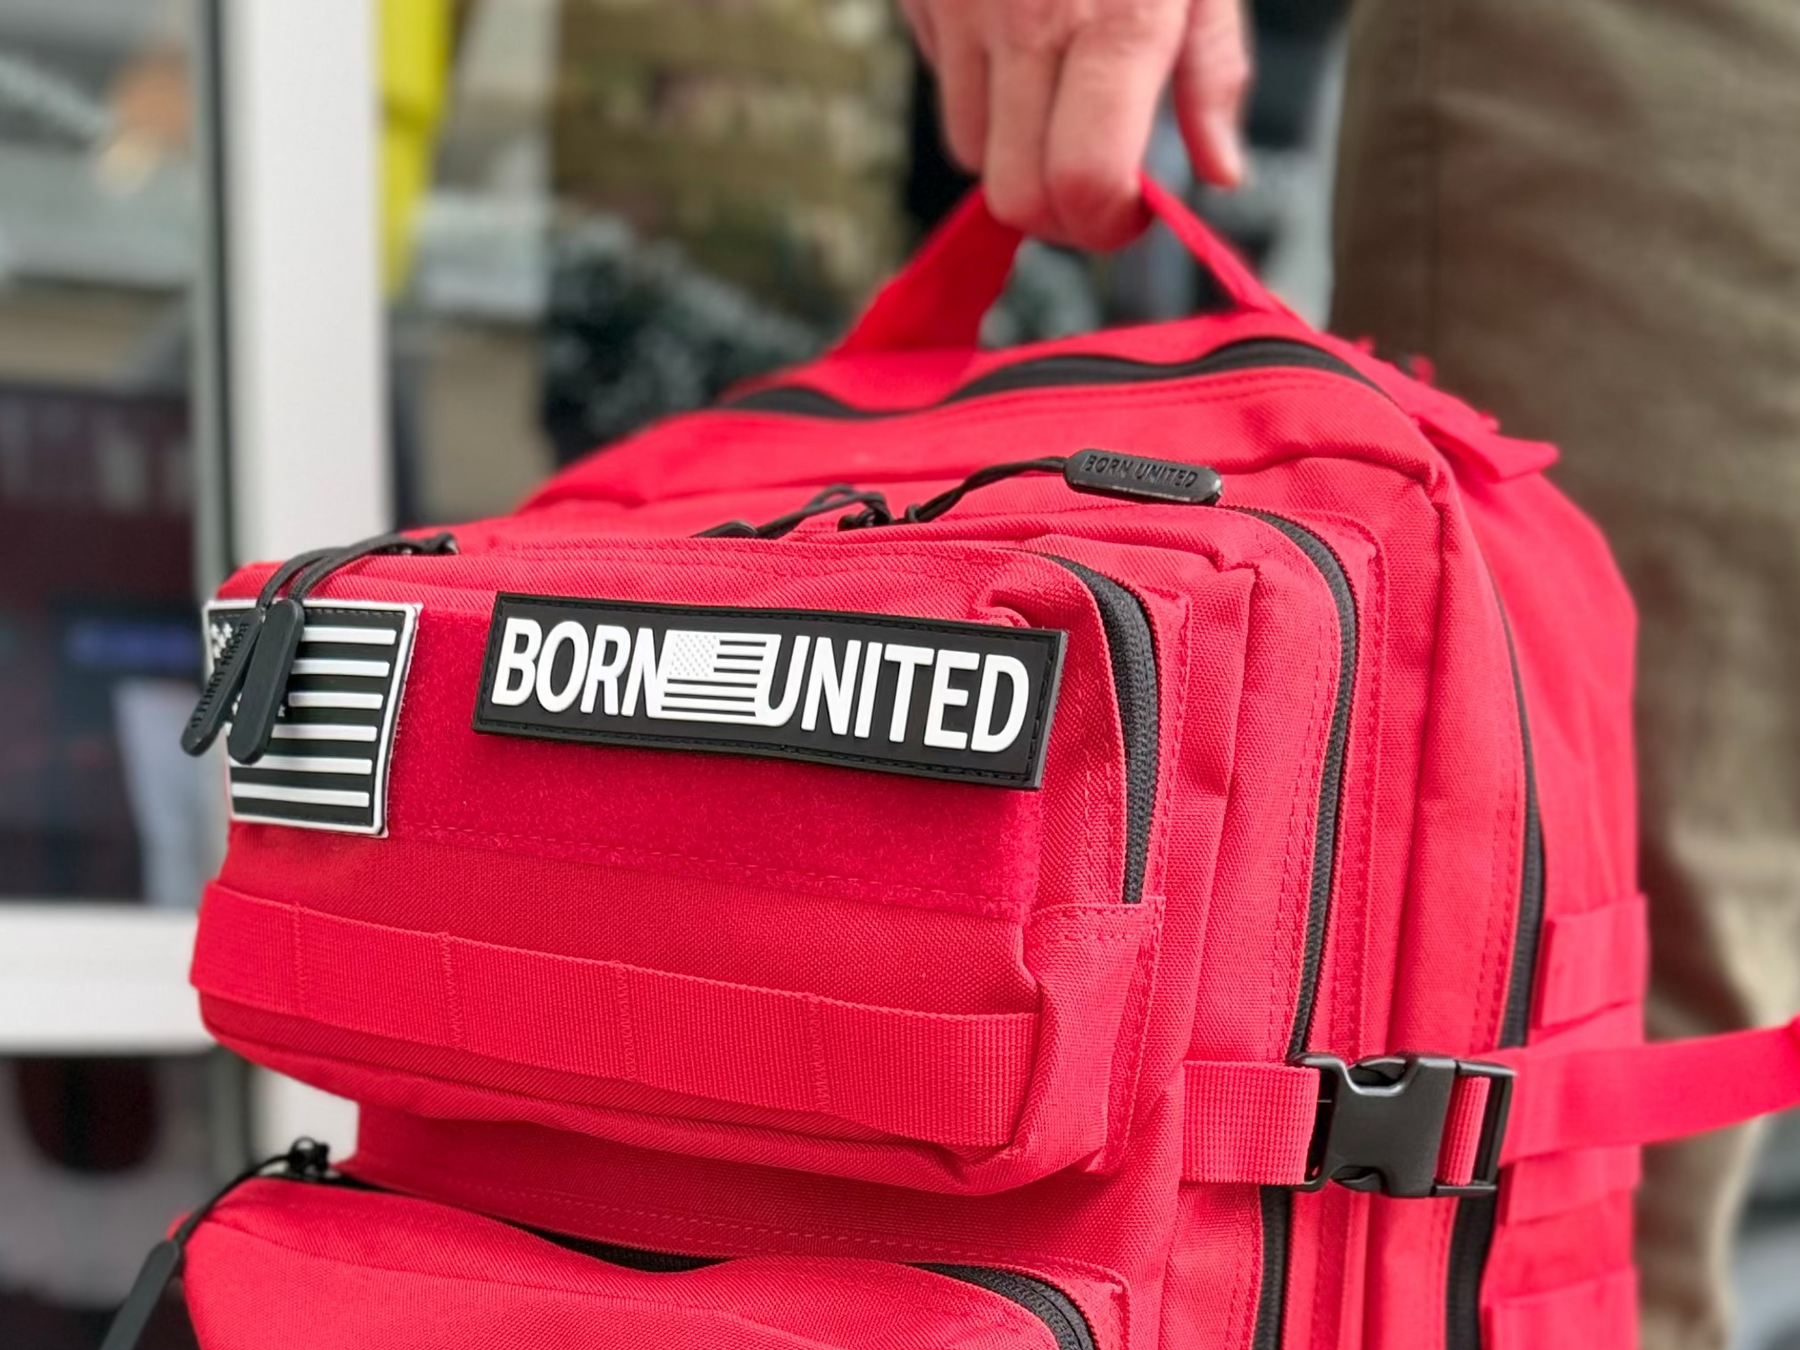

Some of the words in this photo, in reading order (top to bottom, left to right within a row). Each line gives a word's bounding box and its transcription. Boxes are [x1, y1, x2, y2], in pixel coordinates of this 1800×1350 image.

[1084, 454, 1134, 473] BORN
[1136, 462, 1199, 488] UNITED
[491, 617, 669, 720] BORN
[753, 633, 1030, 753] UNITED
